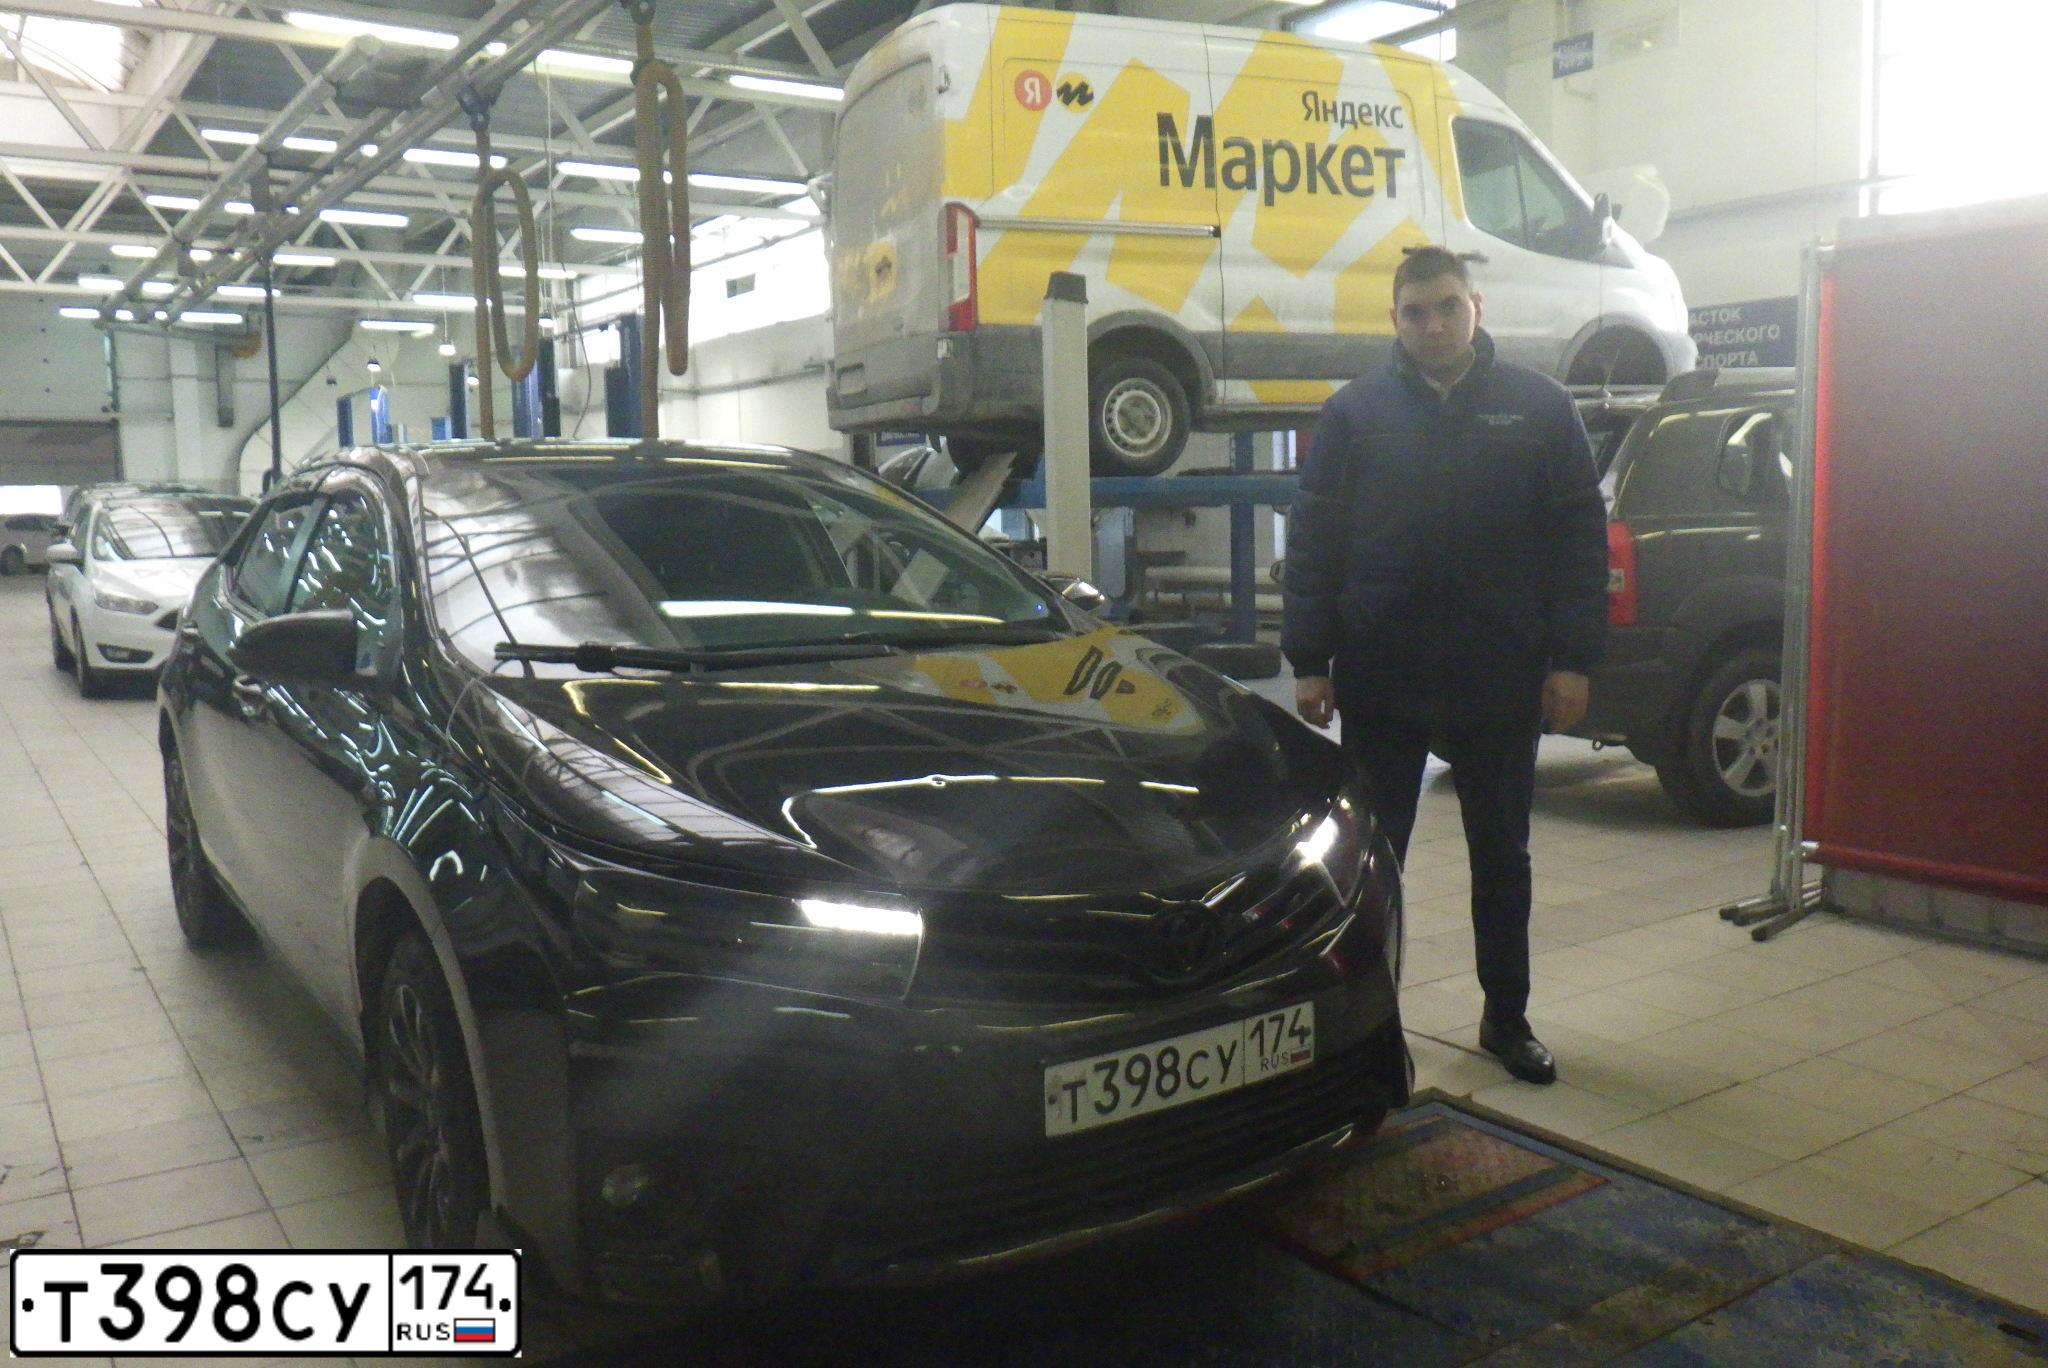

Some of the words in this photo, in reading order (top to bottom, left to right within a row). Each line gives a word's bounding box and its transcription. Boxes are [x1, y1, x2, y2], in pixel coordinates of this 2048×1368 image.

[1301, 90, 1404, 130] Яндекс
[1156, 111, 1406, 207] Маркет
[1688, 306, 1742, 327] АСТОК
[1692, 323, 1780, 344] РЧЕСКОГО
[1062, 1039, 1238, 1124] Т398СУ
[1249, 1007, 1311, 1057] 174
[1259, 1053, 1290, 1072] RUS
